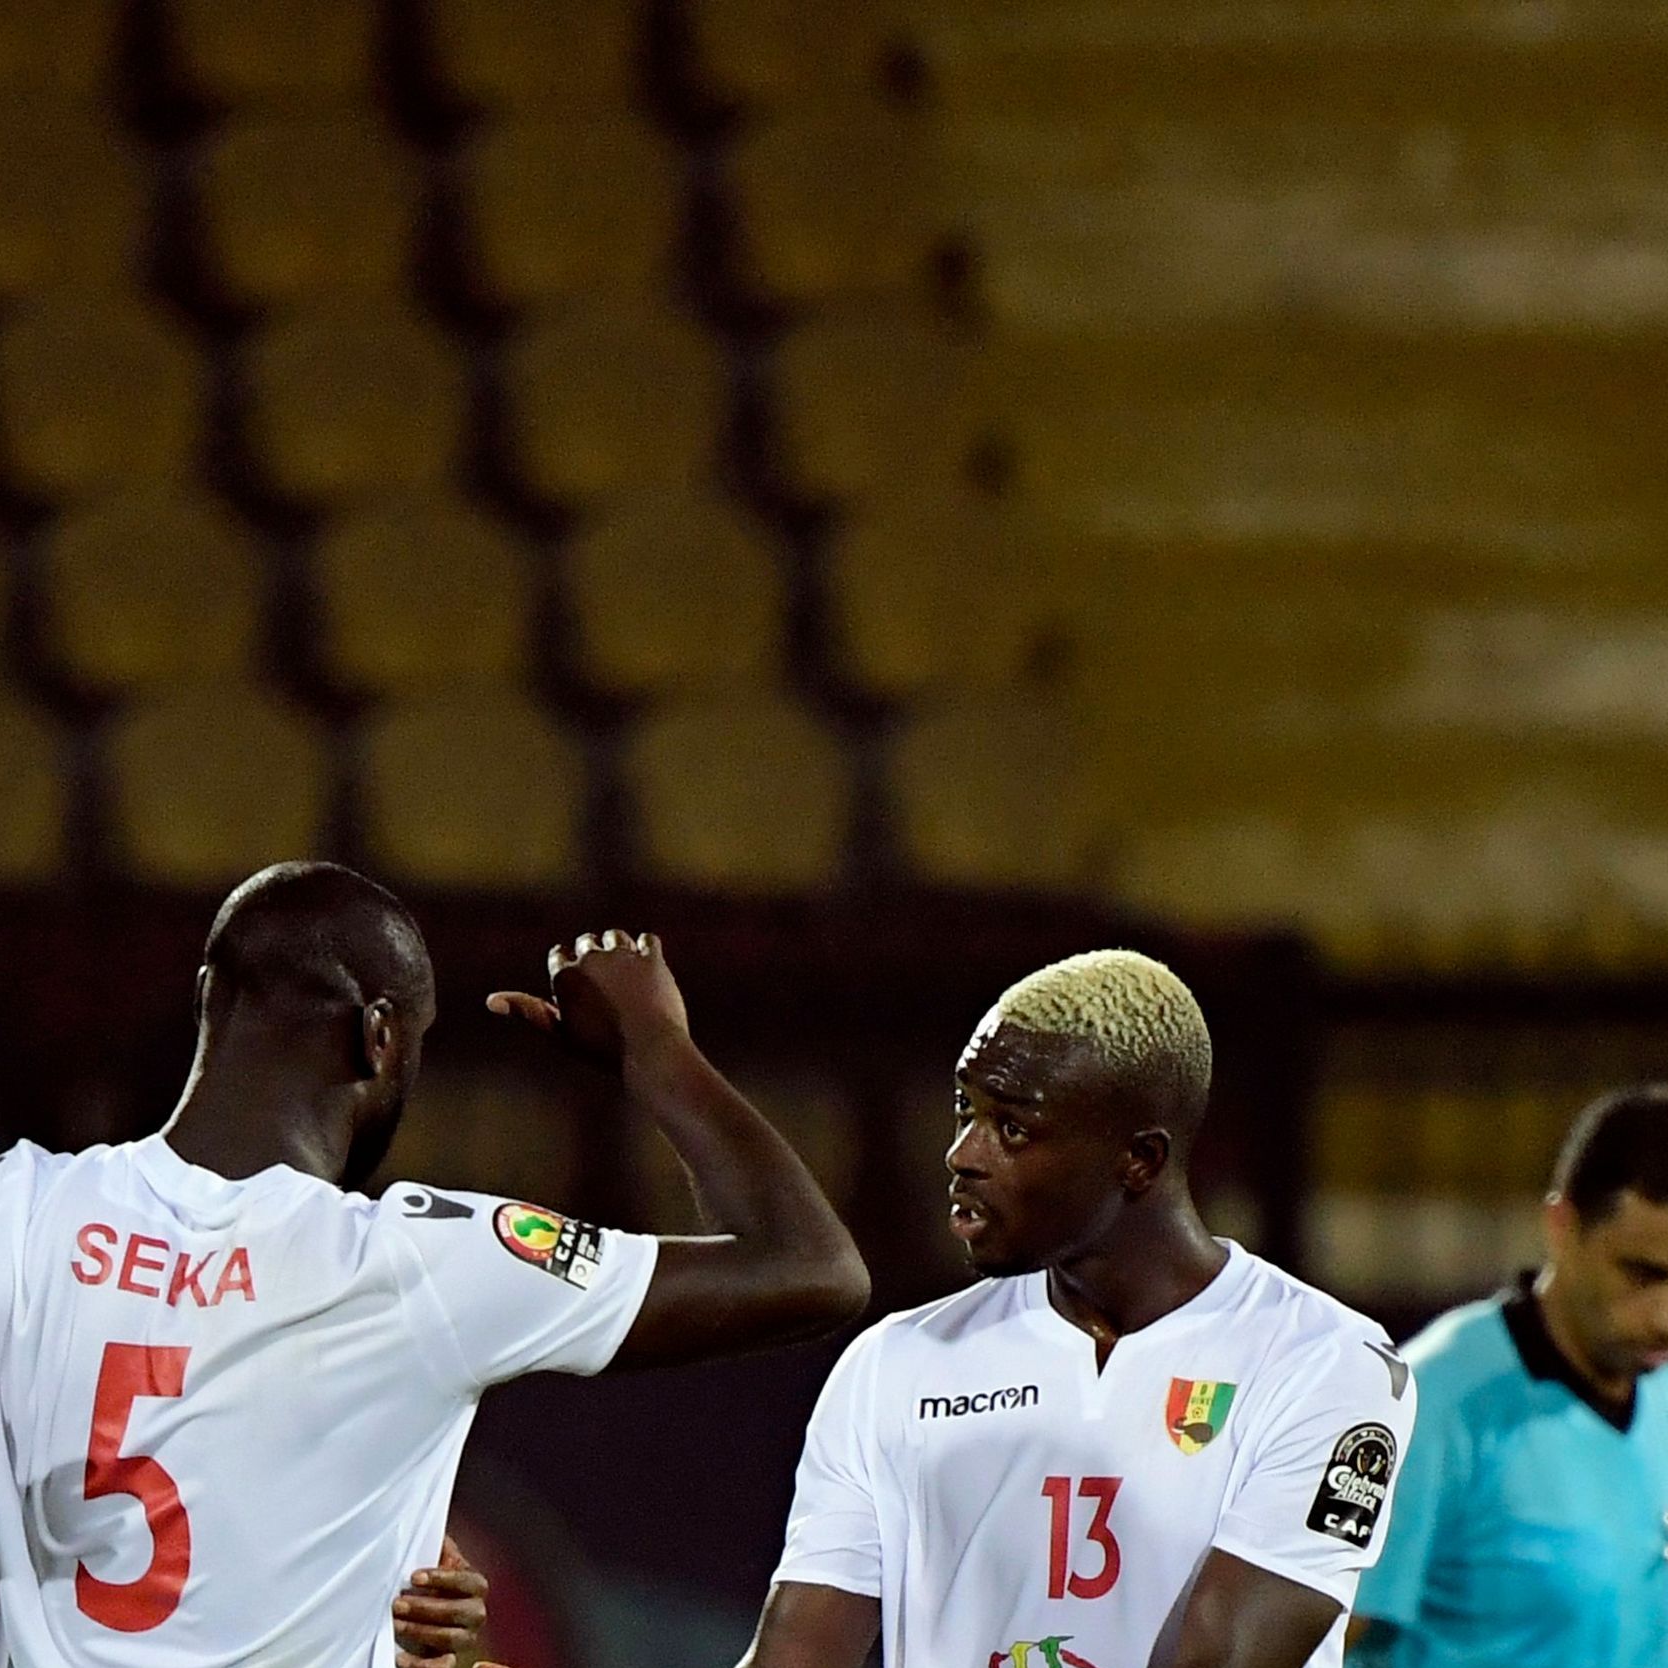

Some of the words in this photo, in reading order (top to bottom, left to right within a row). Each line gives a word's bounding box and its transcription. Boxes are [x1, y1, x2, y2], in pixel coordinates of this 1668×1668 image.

[71, 1223, 255, 1307] SEKA
[919, 1384, 1038, 1419] macron
[75, 1342, 191, 1633] 5
[1324, 1513, 1371, 1538] CAF
[1041, 1476, 1124, 1599] 13
